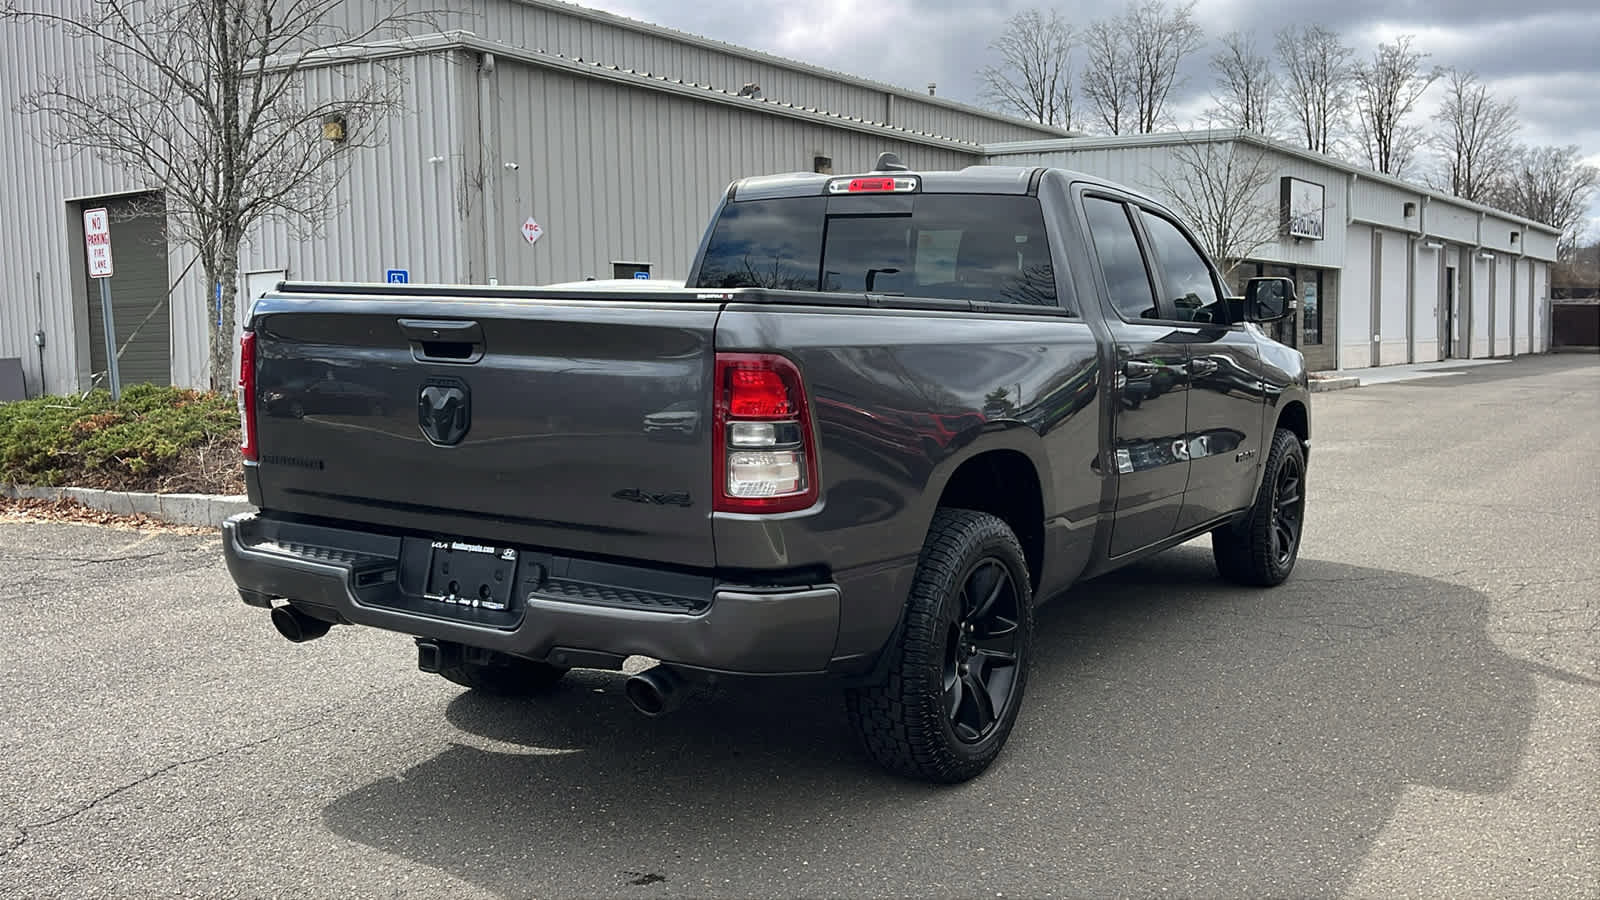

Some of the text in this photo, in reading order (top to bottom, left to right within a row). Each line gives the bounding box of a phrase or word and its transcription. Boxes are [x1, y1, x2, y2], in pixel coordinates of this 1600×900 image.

[92, 216, 101, 229] NO
[87, 232, 109, 245] PARKING
[94, 247, 105, 257] FIRE
[94, 259, 107, 270] LANE
